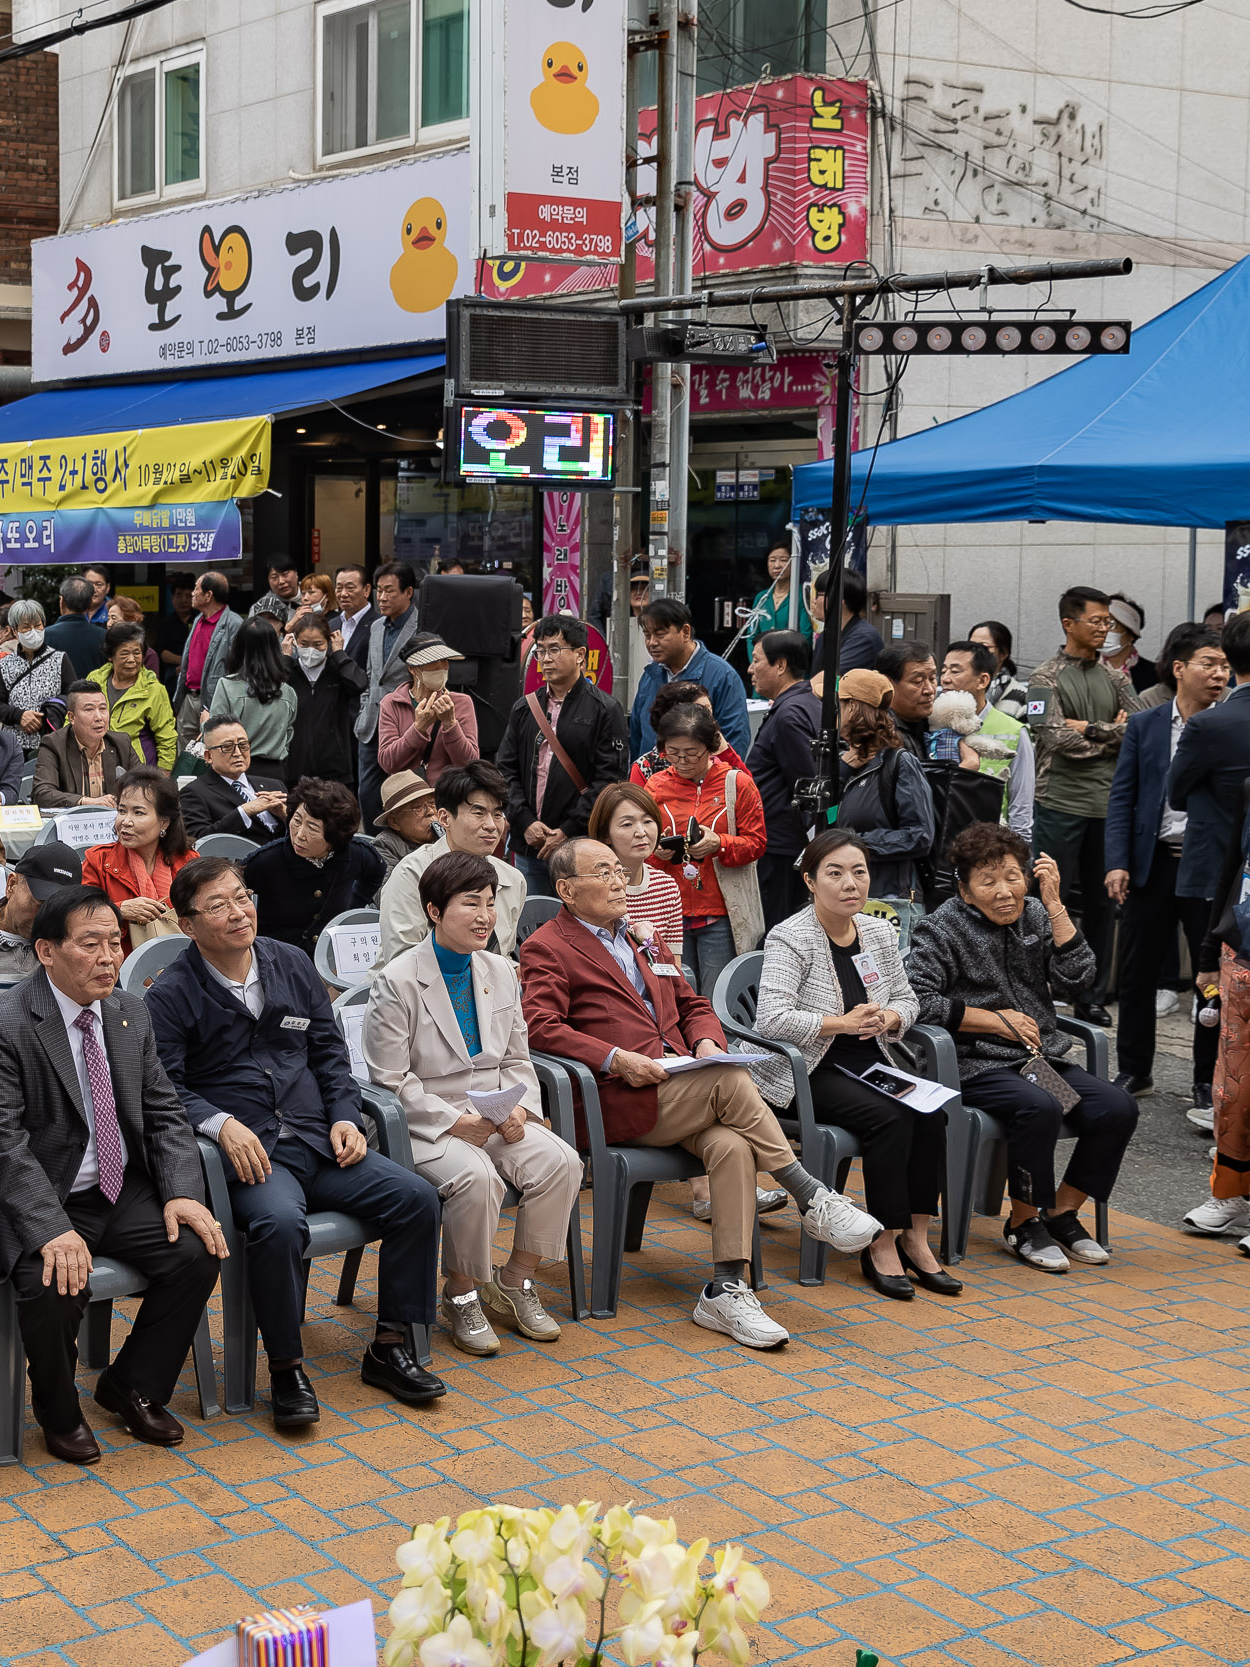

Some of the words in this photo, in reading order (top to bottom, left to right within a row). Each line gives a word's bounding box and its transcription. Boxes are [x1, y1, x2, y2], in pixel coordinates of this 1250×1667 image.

[550, 164, 579, 185] 본점
[808, 87, 846, 253] 노래방
[538, 204, 587, 225] 예약문의
[512, 229, 612, 253] T.02-6053-3798
[60, 256, 100, 356] 多
[158, 339, 195, 361] 예약문의
[198, 331, 283, 357] T.02-6053-3798
[294, 325, 316, 346] 본점
[692, 370, 709, 404] 갈
[716, 370, 729, 401] 수
[58, 446, 130, 494] 2+1행사
[172, 508, 196, 527] 1만원
[351, 935, 379, 947] 구의원
